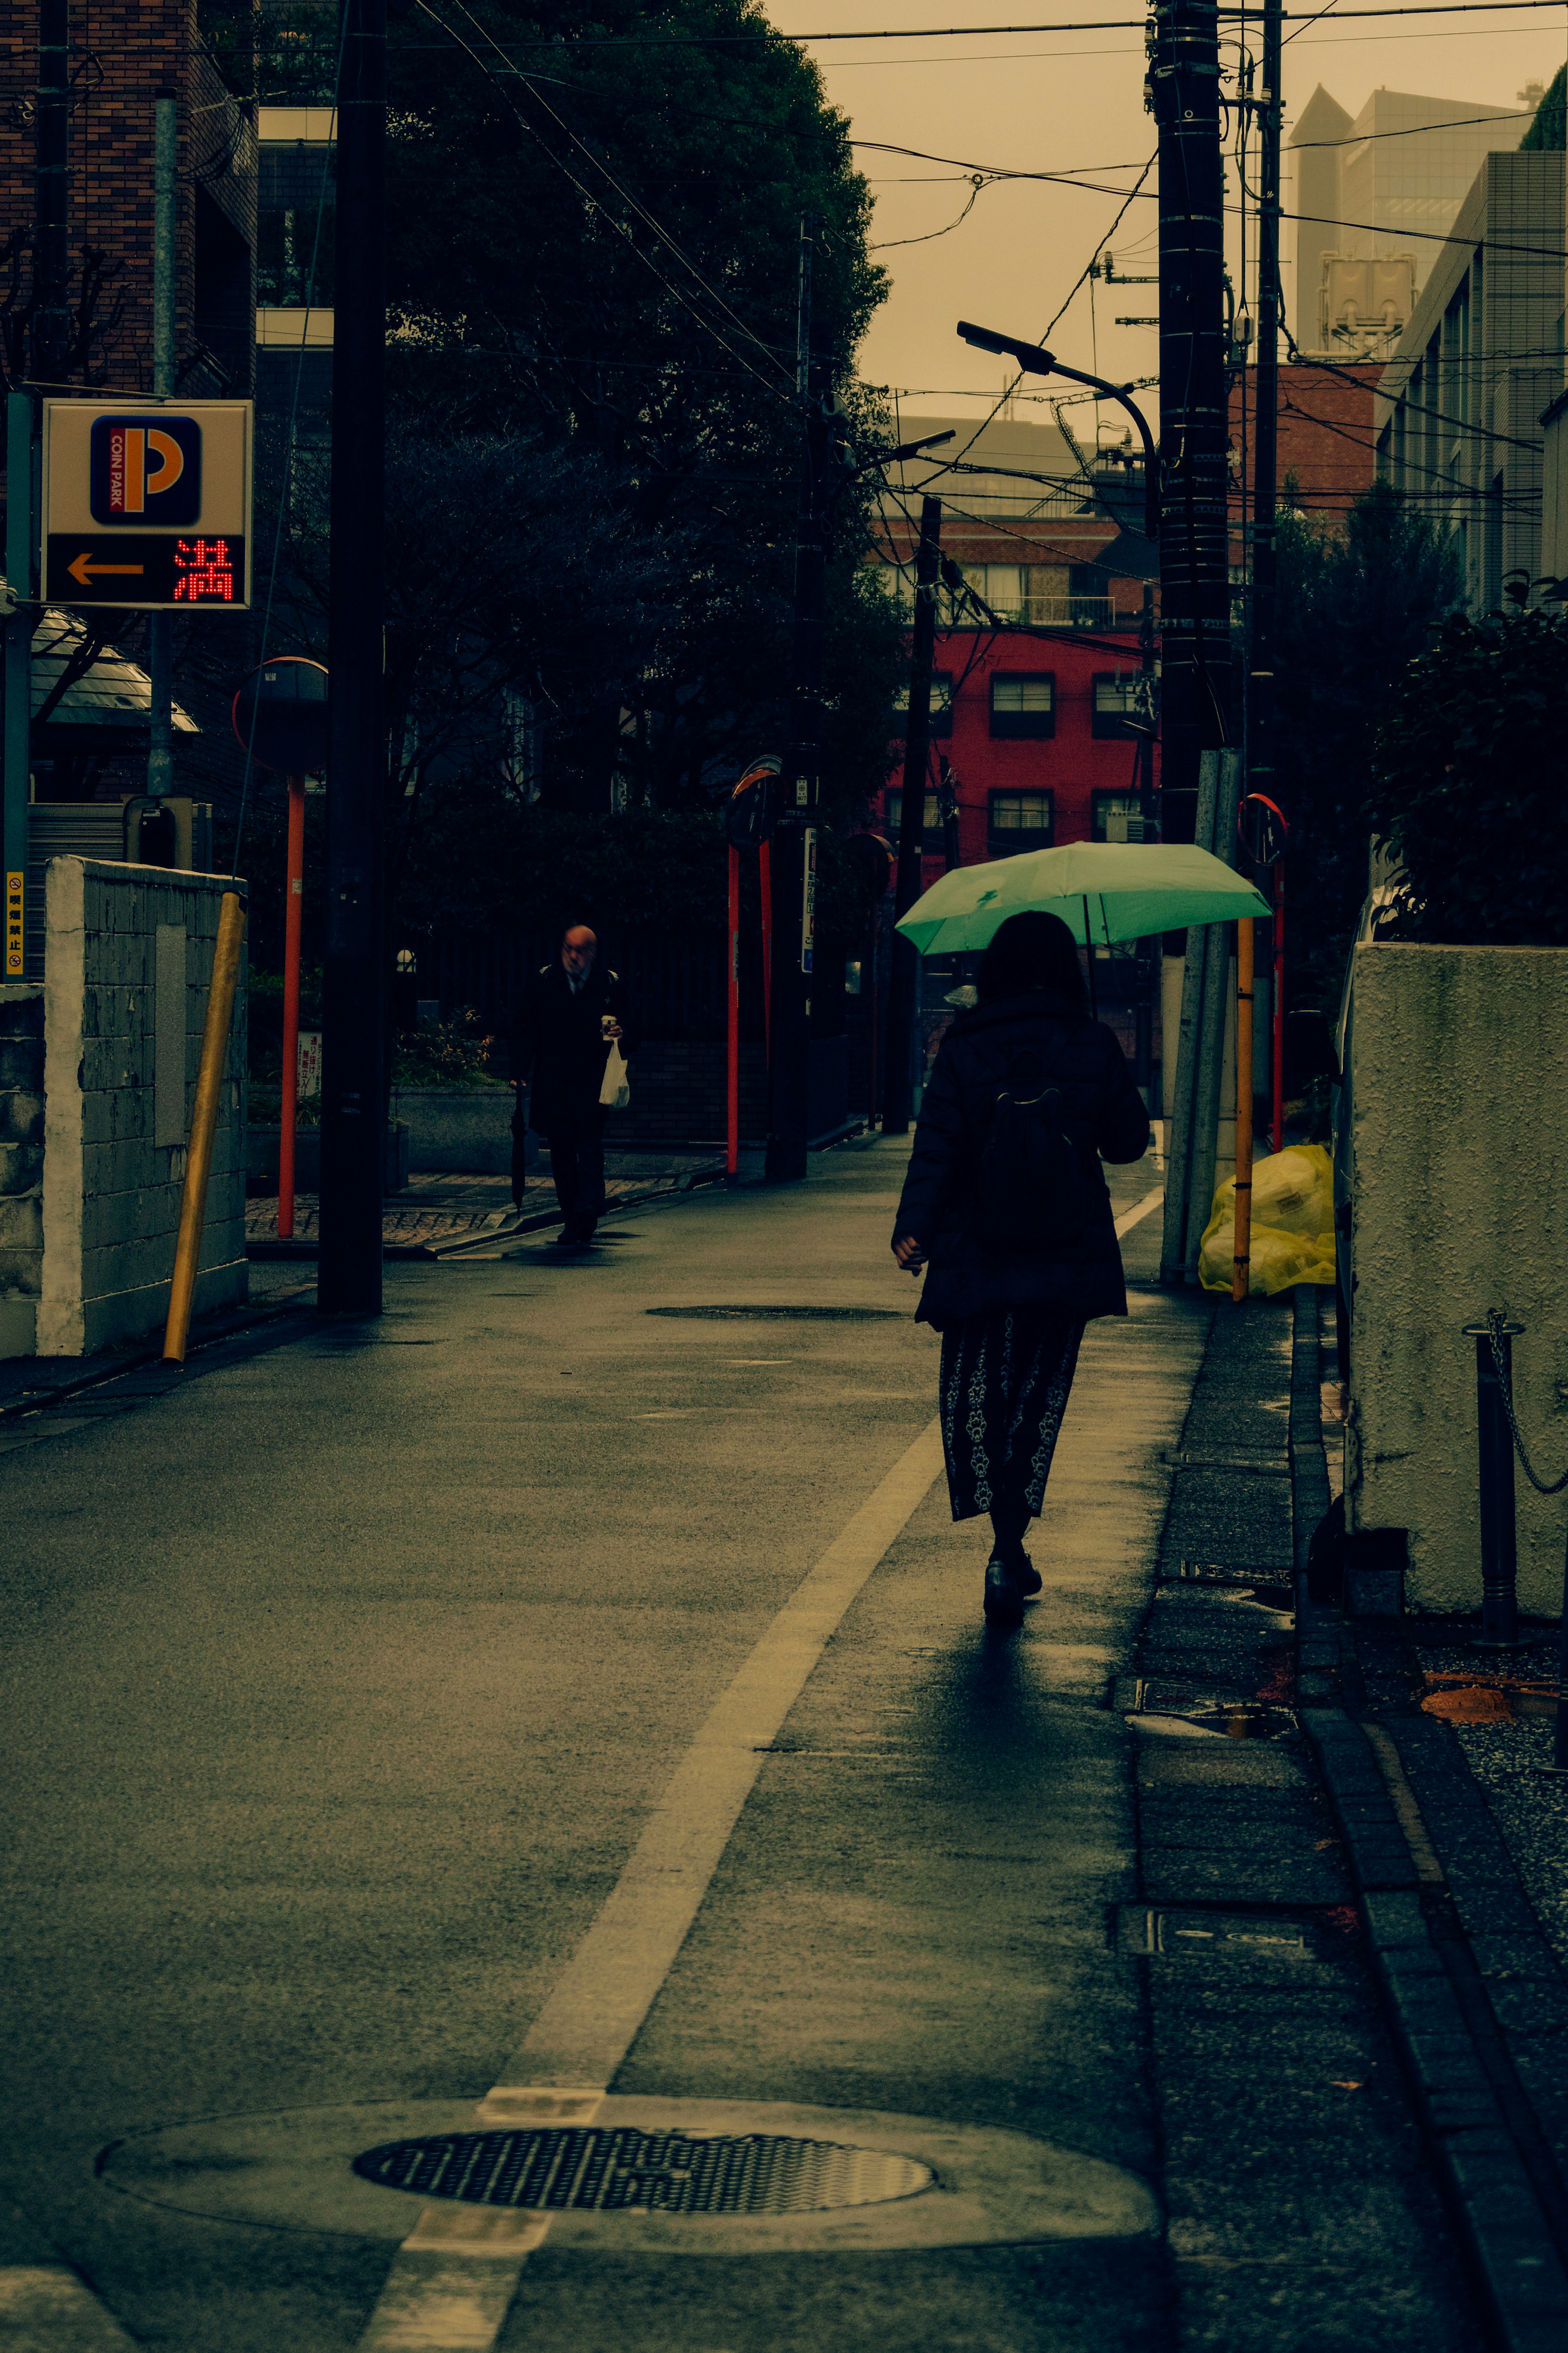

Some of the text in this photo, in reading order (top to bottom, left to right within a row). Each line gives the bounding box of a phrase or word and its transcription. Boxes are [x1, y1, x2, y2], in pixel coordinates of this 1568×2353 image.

[111, 435, 122, 506] COIN PARK
[173, 539, 233, 601] 満
[9, 894, 21, 950] 喫煙禁止
